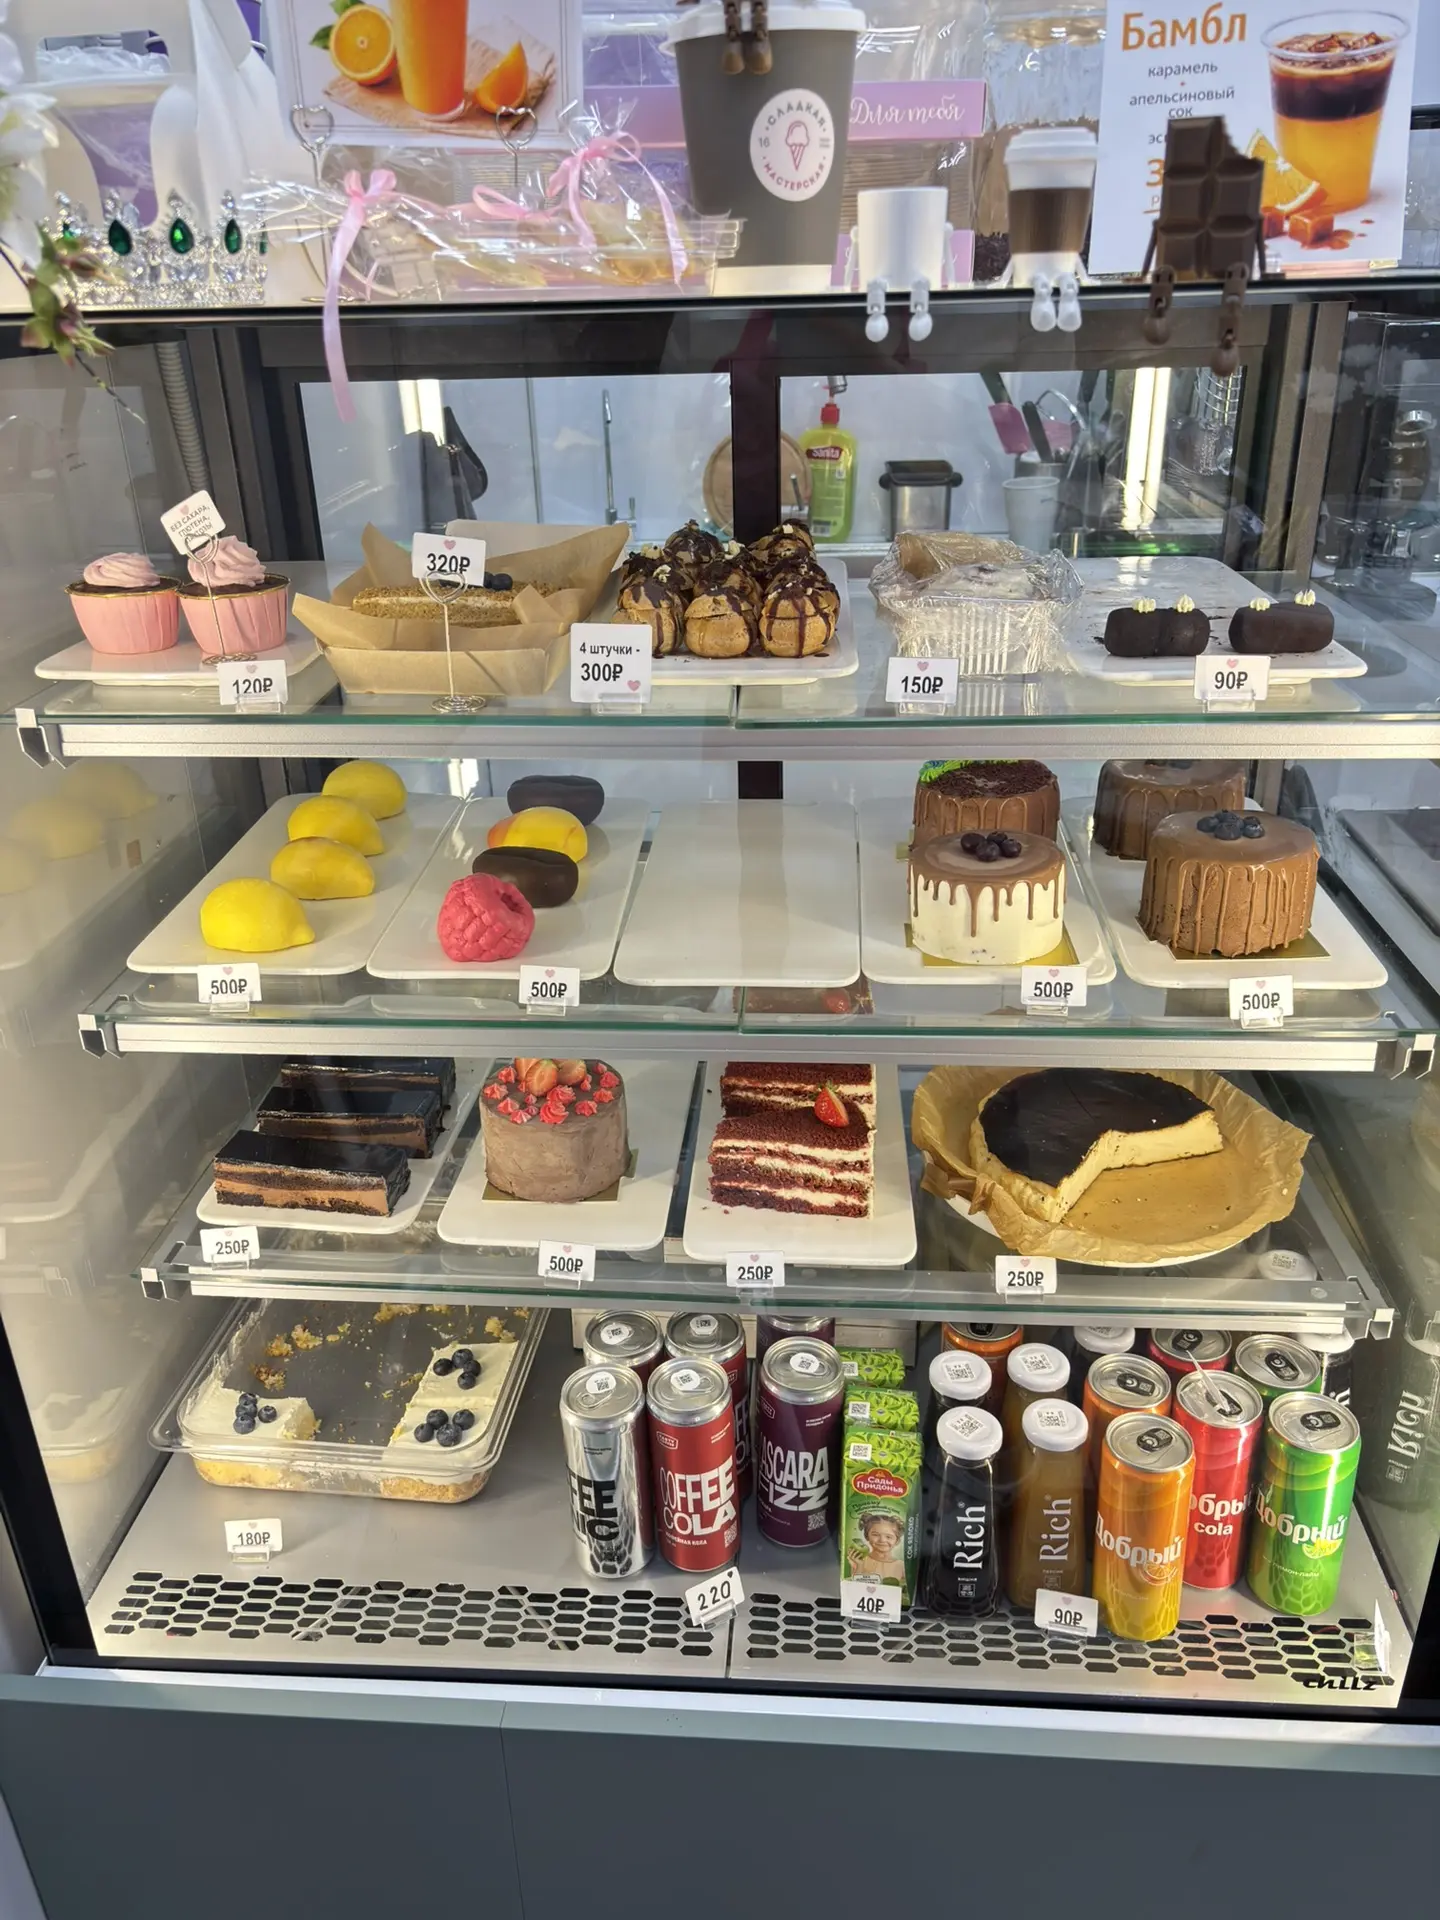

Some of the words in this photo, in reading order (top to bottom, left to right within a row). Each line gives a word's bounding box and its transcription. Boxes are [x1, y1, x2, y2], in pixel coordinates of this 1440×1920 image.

[1121, 2, 1248, 51] Бамбл
[1148, 62, 1218, 78] карамель
[1129, 87, 1235, 106] апельсиновый
[1168, 107, 1193, 119] сок
[763, 162, 825, 191] МАСТЕРСКАЯ
[579, 642, 587, 654] 4
[590, 645, 632, 657] штучки
[760, 1431, 830, 1490] ASCARA
[660, 1454, 735, 1513] COFFEE
[856, 1481, 904, 1494] Придонья
[867, 1476, 894, 1486] Сады
[663, 1499, 737, 1536] COLA
[1039, 1498, 1072, 1561] Rich
[1194, 1522, 1233, 1536] cola
[1256, 1486, 1347, 1545] Добрый
[953, 1505, 986, 1569] Rich
[1096, 1510, 1184, 1568] Добрый
[698, 1580, 731, 1611] 220
